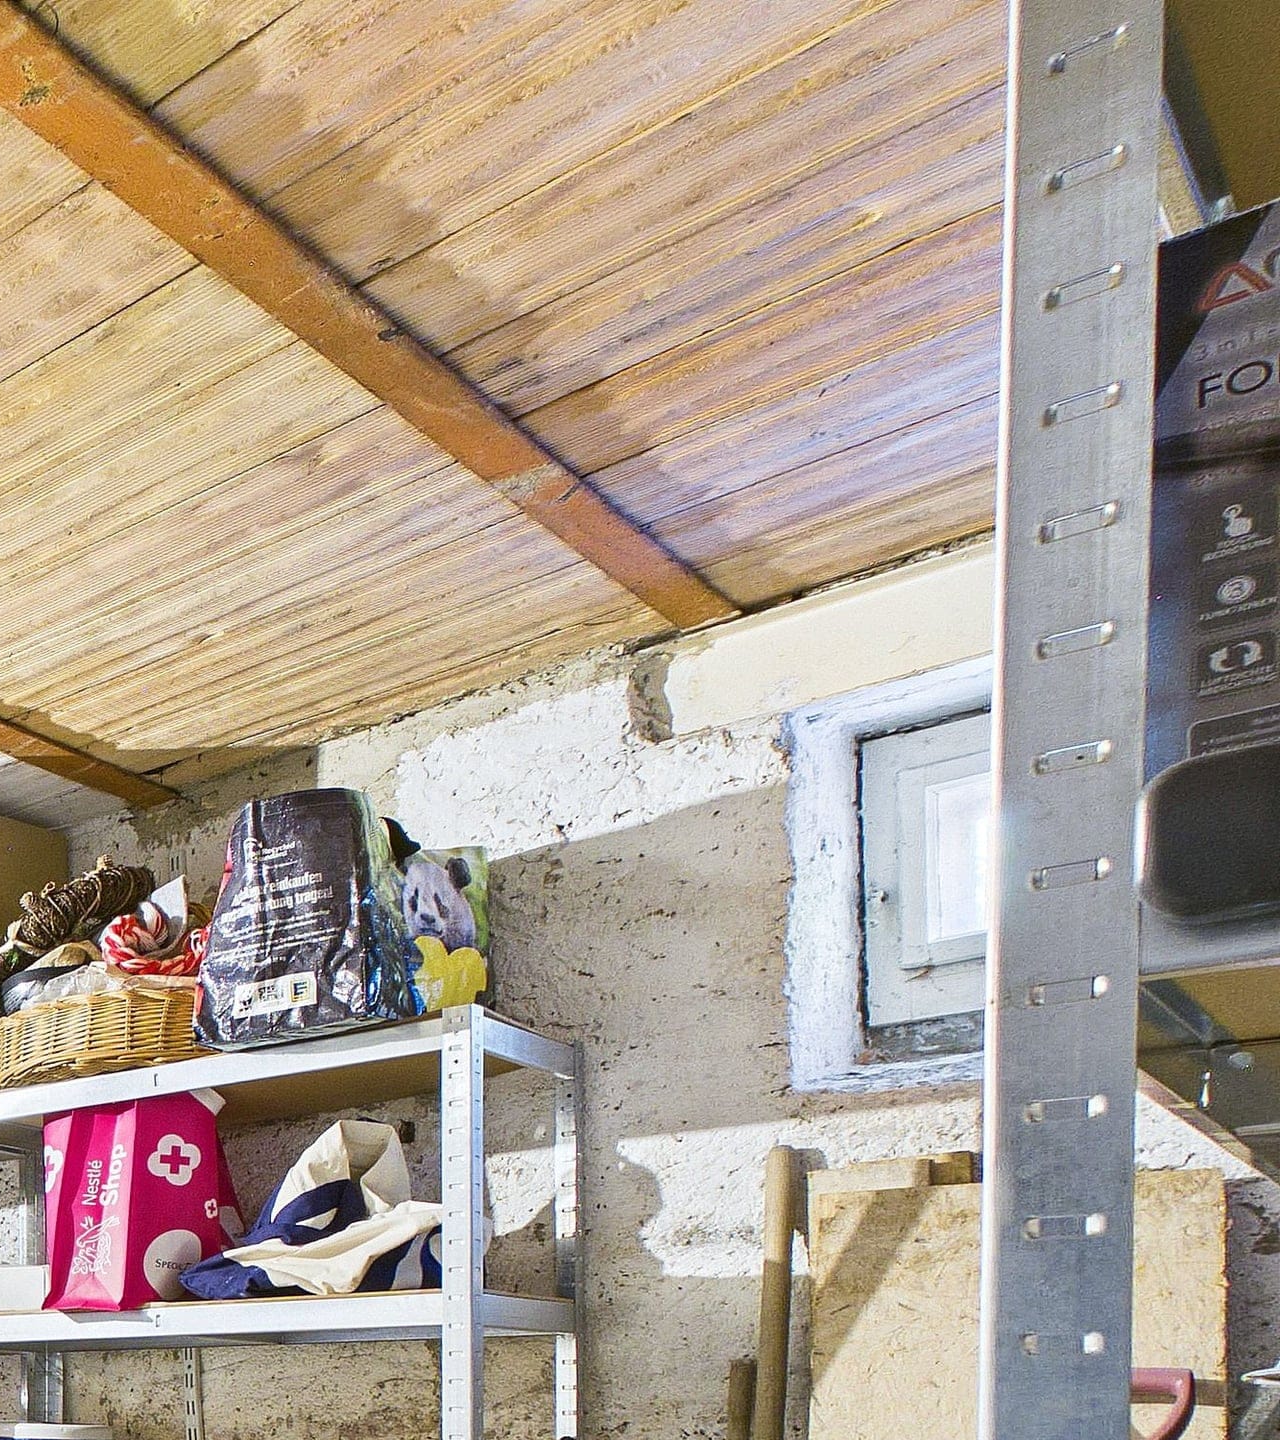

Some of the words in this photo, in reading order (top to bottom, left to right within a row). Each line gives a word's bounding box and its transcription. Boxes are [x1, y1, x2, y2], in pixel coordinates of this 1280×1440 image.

[1197, 353, 1280, 410] FO
[81, 1159, 103, 1206] Nestlé
[99, 1143, 127, 1207] Shop
